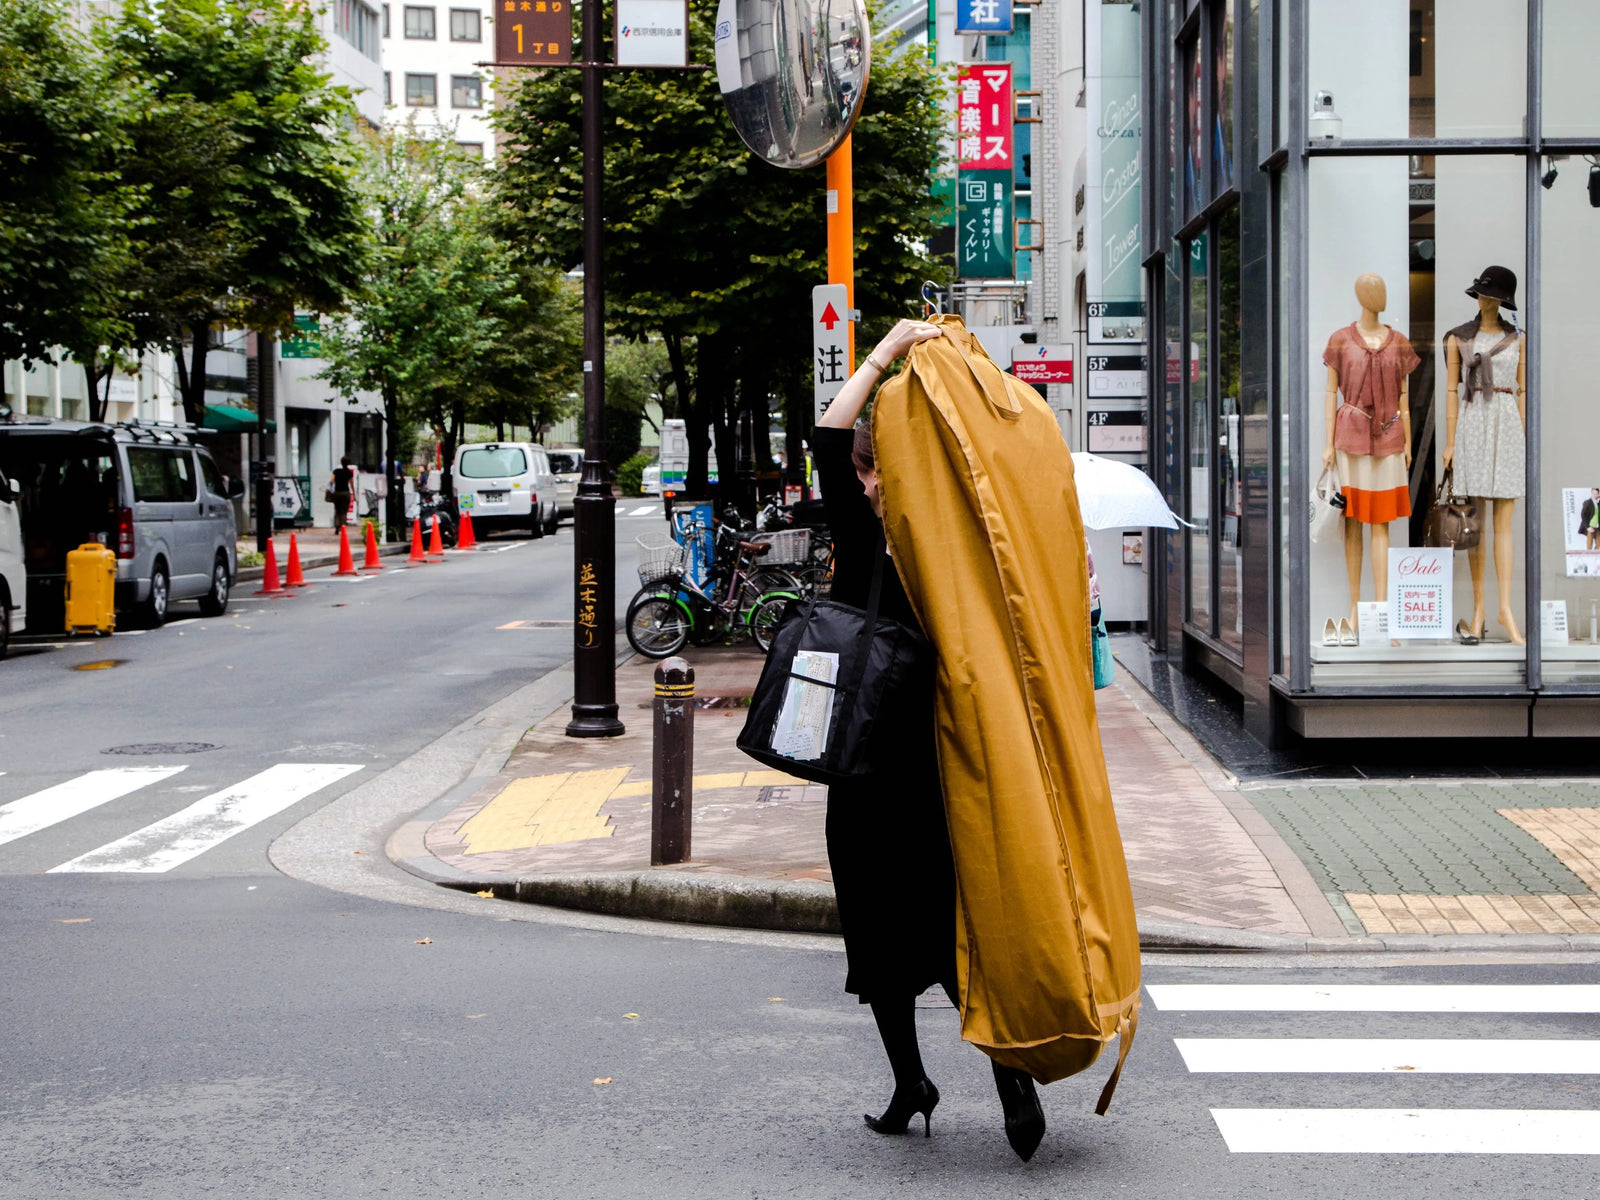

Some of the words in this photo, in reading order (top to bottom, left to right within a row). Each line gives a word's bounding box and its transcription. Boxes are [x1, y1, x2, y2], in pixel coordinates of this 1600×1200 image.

[504, 0, 562, 13] 並木通り
[632, 27, 682, 37] 西京信用金庫
[960, 78, 981, 161] 音楽院
[982, 69, 1008, 161] マース
[1103, 94, 1137, 135] Ginza
[1102, 151, 1140, 203] Crystal
[981, 207, 991, 262] ギャラリー
[1104, 223, 1139, 268] Tower
[1088, 303, 1109, 317] 6F
[1088, 357, 1109, 371] 5F
[1088, 412, 1109, 425] 4F
[1397, 552, 1442, 580] Sale
[578, 562, 599, 647] 並木通り
[1403, 591, 1436, 599] 店内一部
[1403, 601, 1436, 612] SALE
[1403, 614, 1439, 623] あります。
